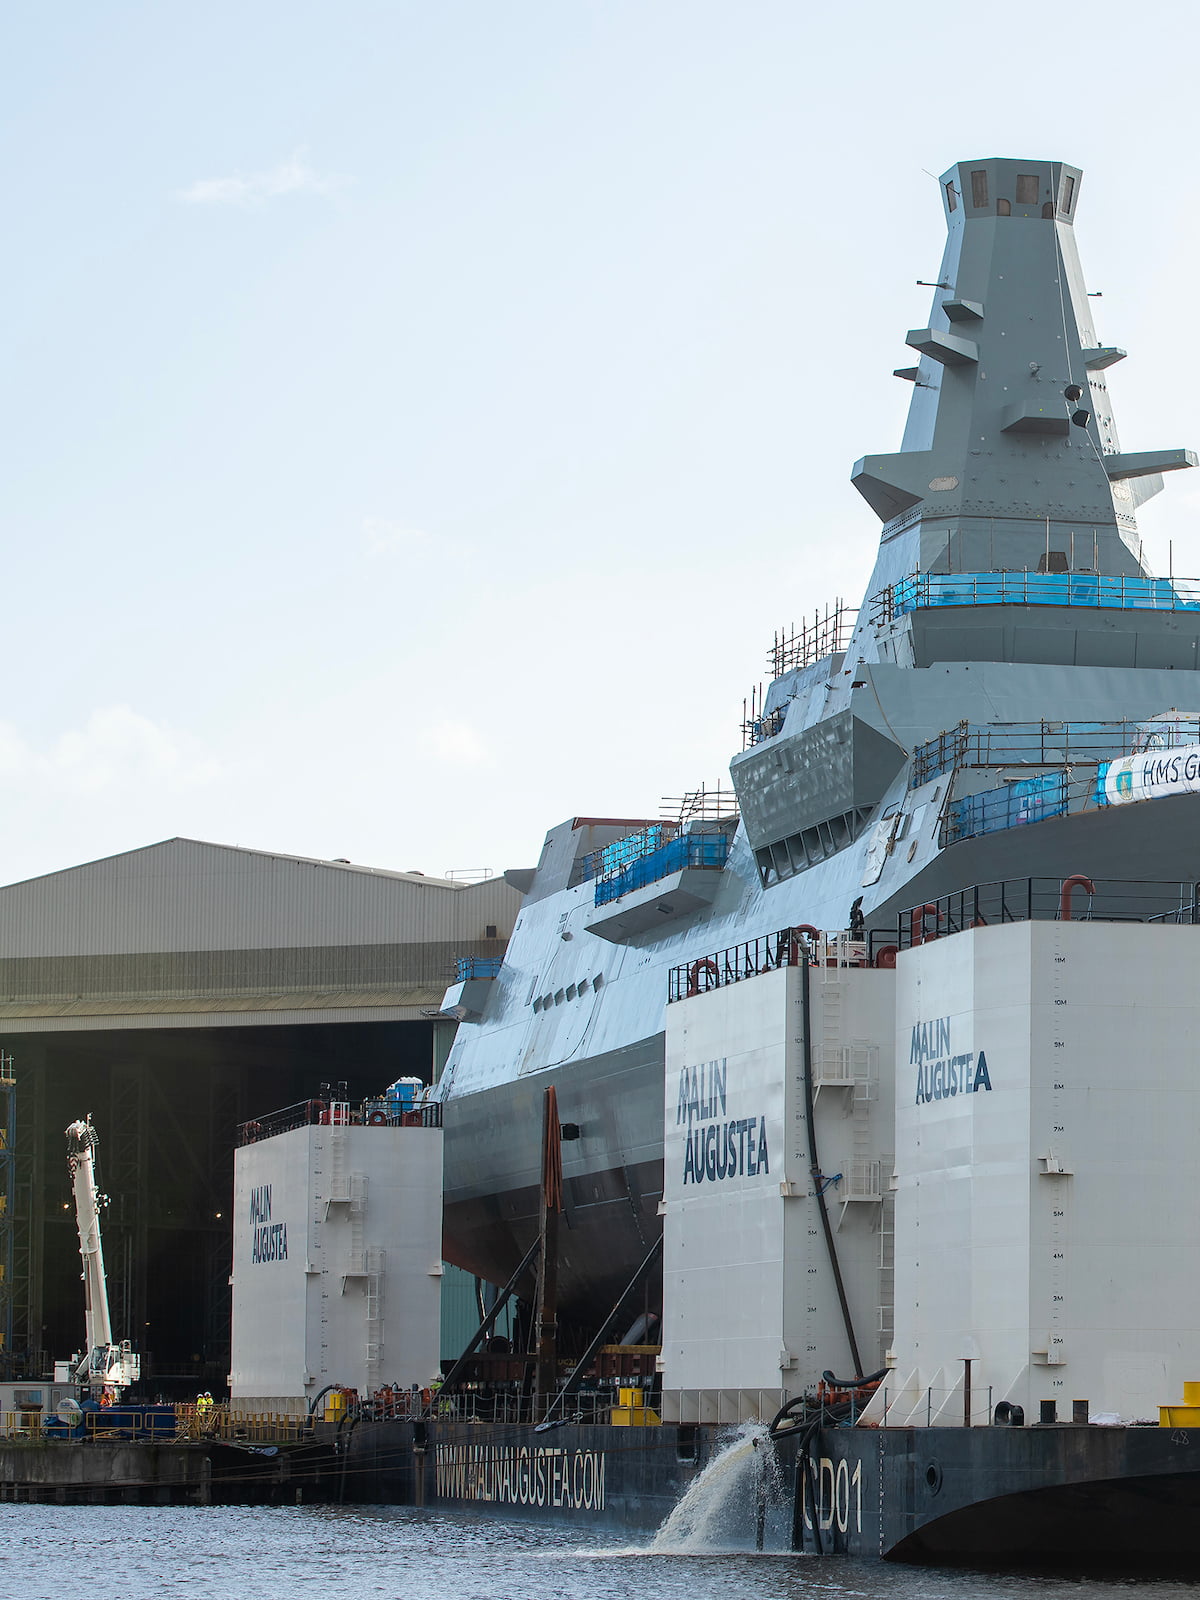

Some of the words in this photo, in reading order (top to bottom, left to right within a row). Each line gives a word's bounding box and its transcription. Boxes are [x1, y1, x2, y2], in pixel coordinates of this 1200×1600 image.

[1143, 756, 1179, 786] HMS
[909, 1016, 951, 1065] MALIN
[676, 1057, 727, 1125] MALIN
[915, 1050, 992, 1105] AUGUSTEA
[683, 1116, 769, 1185] AUGUSTEA
[249, 1184, 272, 1225] MALIN
[252, 1222, 288, 1264] AUGUSTEA
[1052, 1252, 1064, 1260] 4M
[1052, 1337, 1064, 1345] 2M
[436, 1443, 605, 1511] WWW.MALINAUGUSTEA.COM
